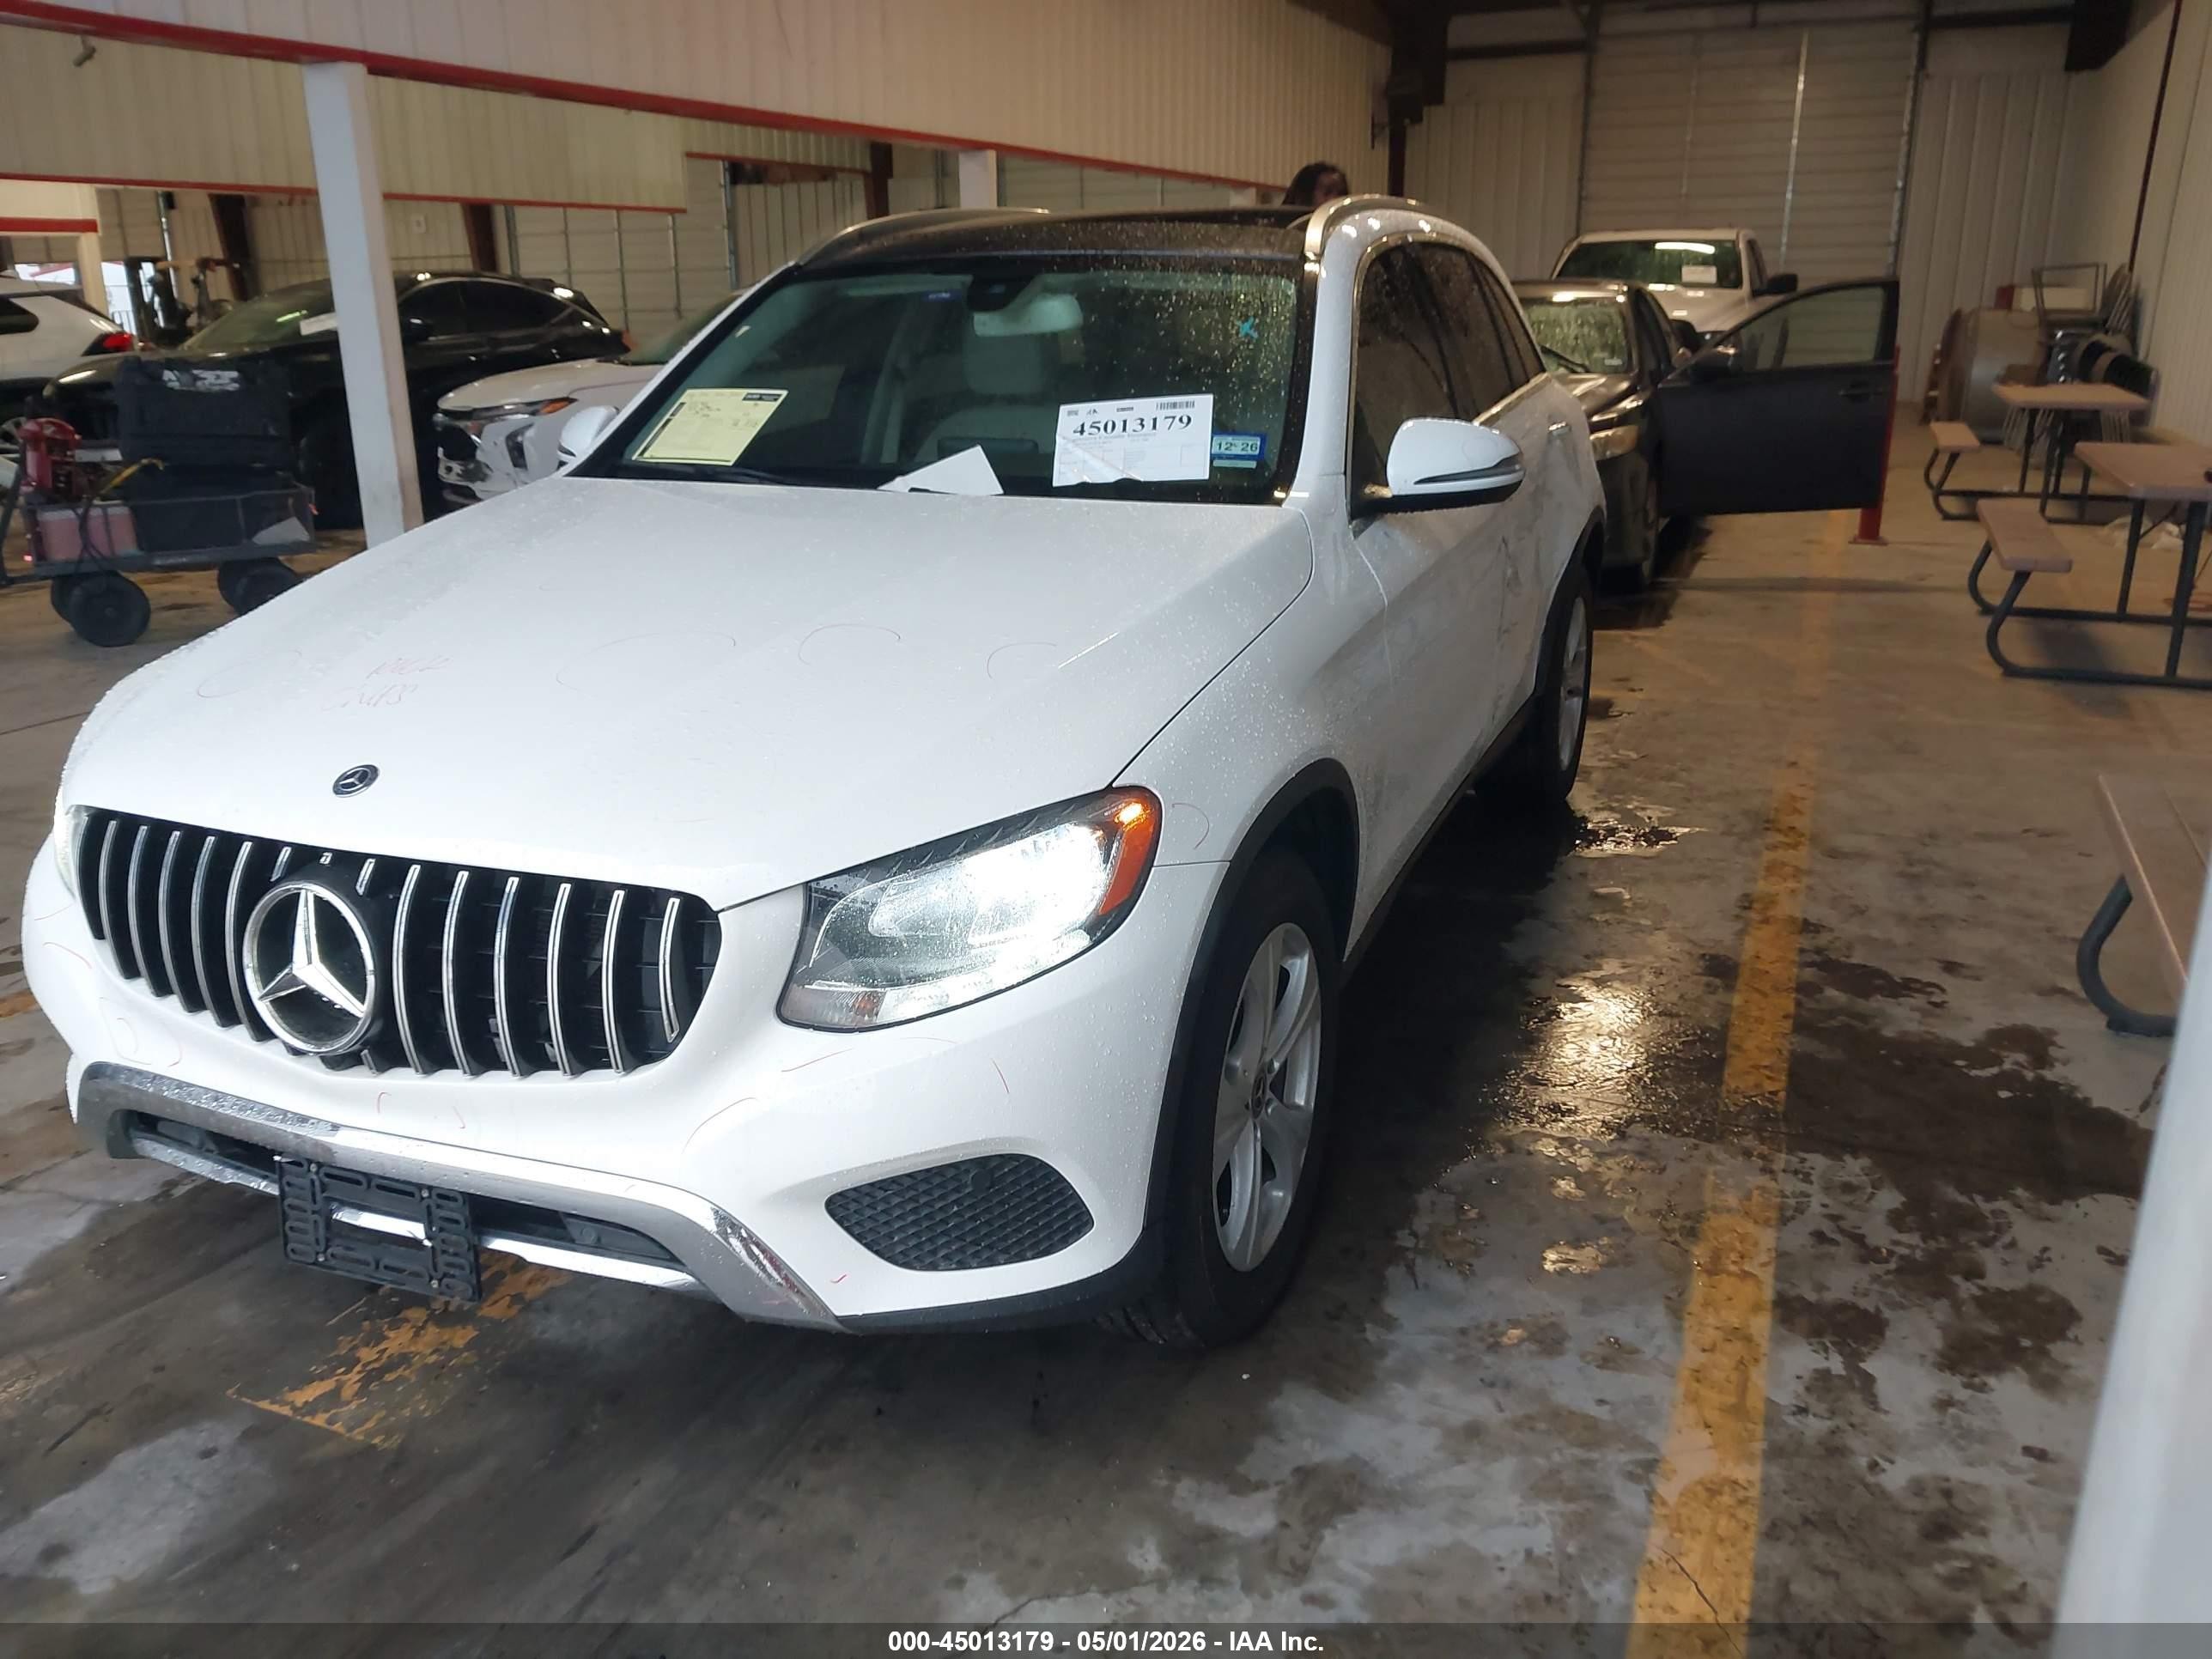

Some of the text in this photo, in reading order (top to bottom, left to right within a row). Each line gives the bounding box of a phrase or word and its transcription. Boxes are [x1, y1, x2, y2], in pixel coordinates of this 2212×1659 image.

[1073, 414, 1192, 436] 45013179
[1217, 441, 1258, 452] 12 26
